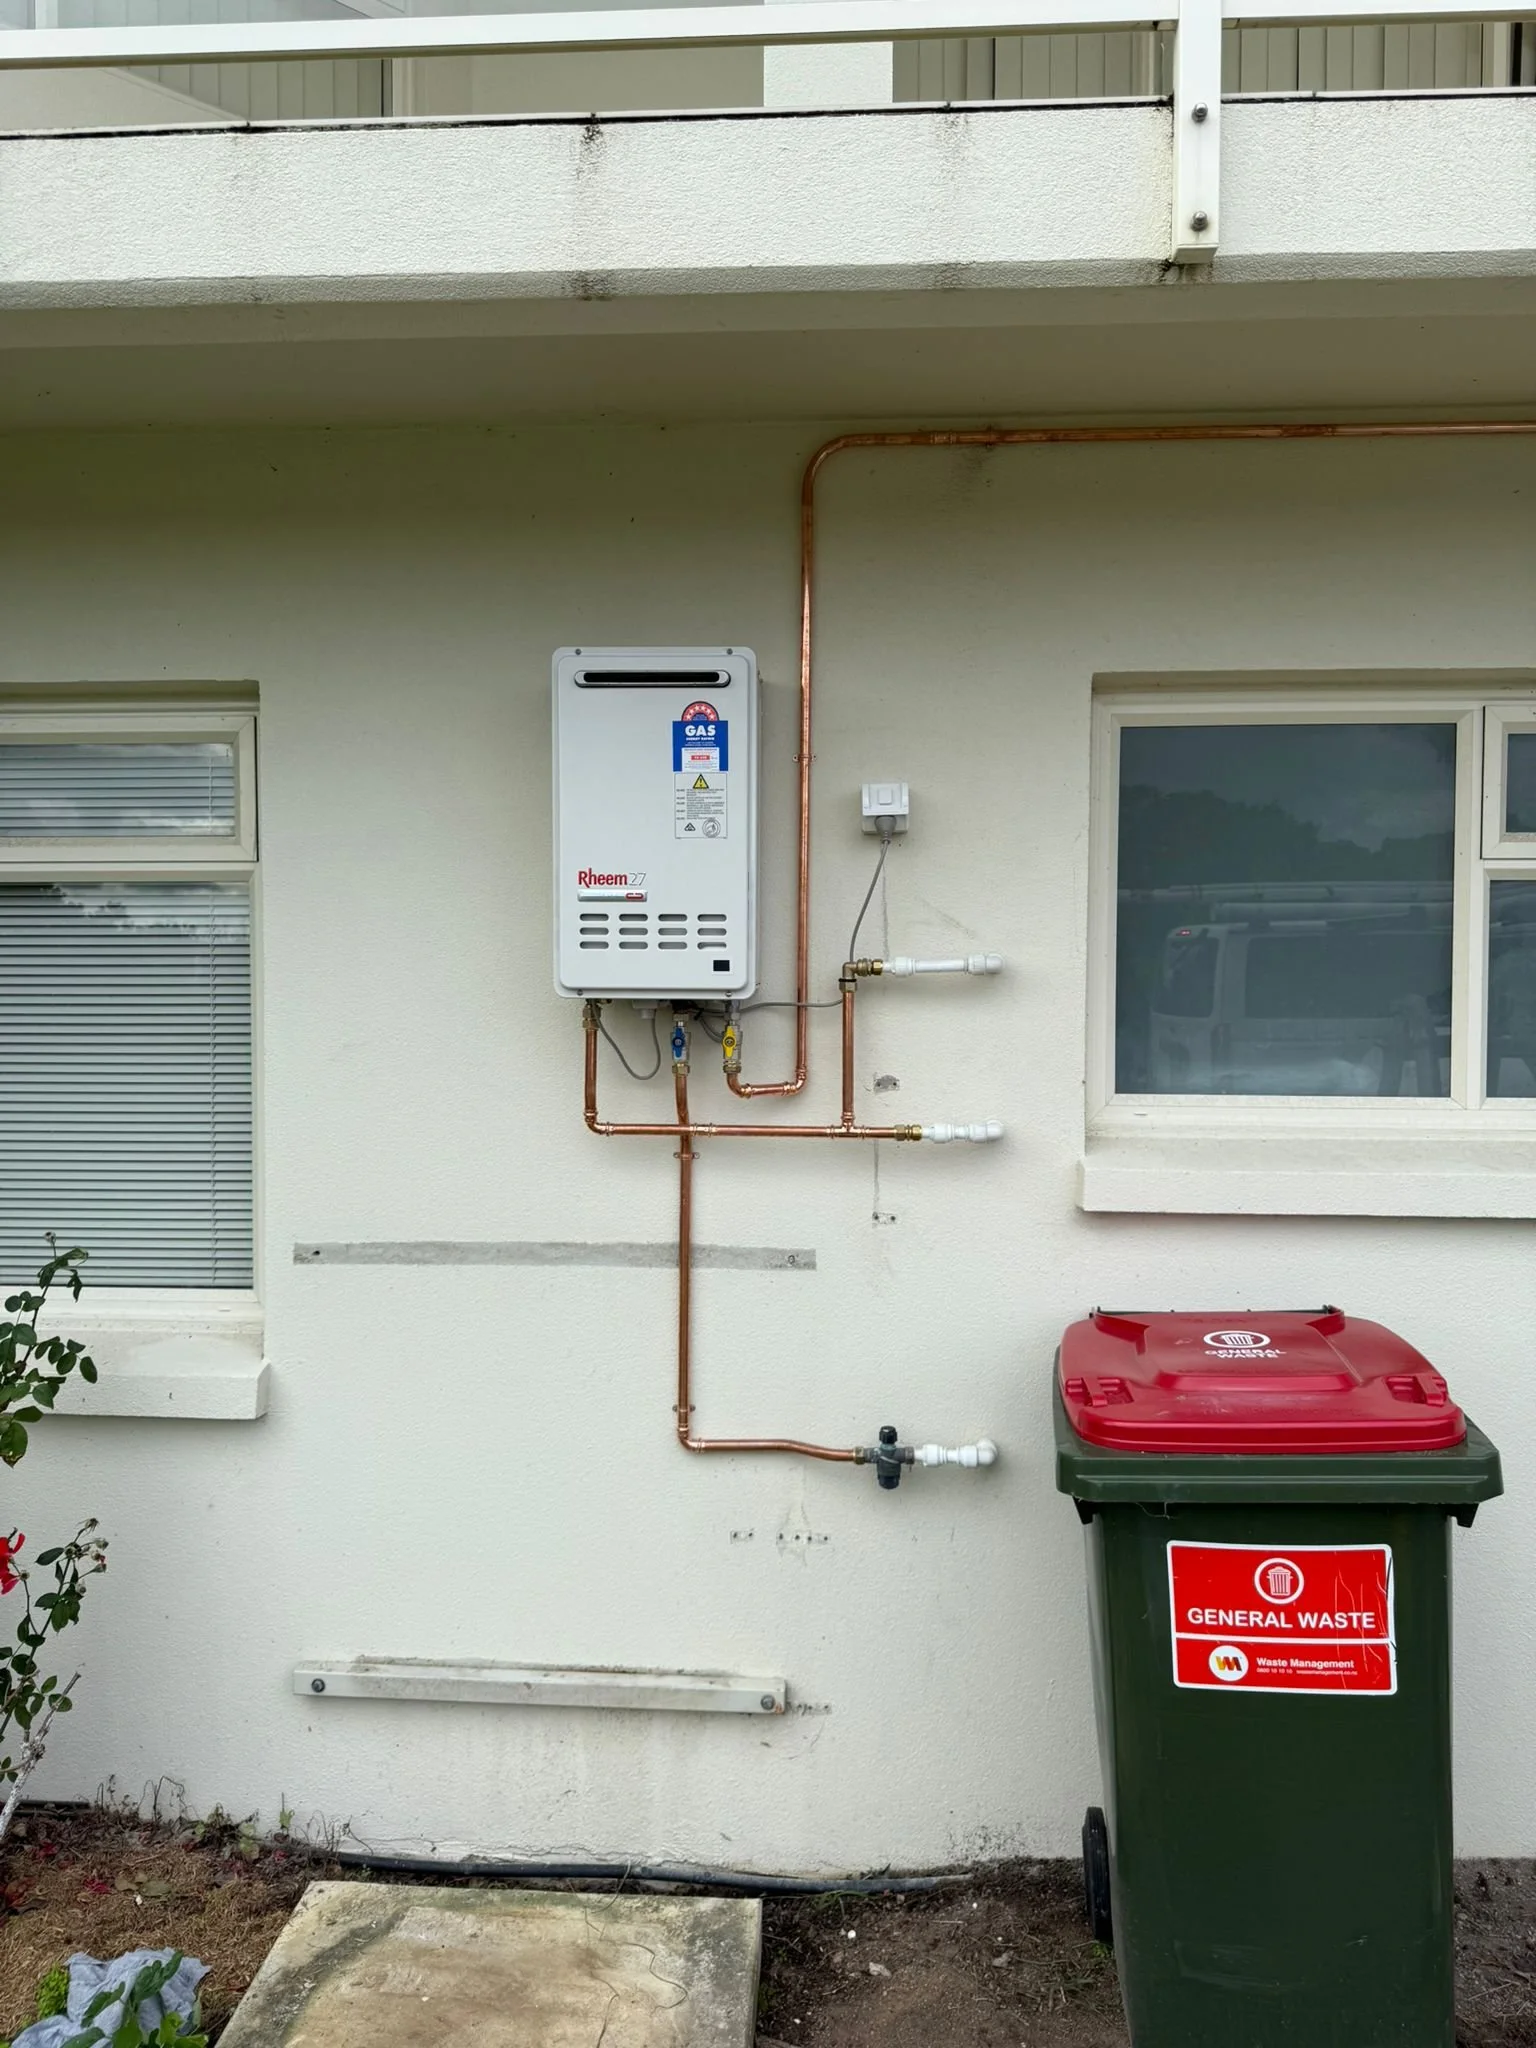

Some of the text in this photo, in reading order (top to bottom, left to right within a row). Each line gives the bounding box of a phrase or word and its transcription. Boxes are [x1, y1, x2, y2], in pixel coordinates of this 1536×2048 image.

[685, 725, 716, 737] GAS
[578, 868, 647, 888] Rheem 27
[1187, 1607, 1376, 1629] GENERAL WASTE
[1256, 1657, 1354, 1669] Waste Management
